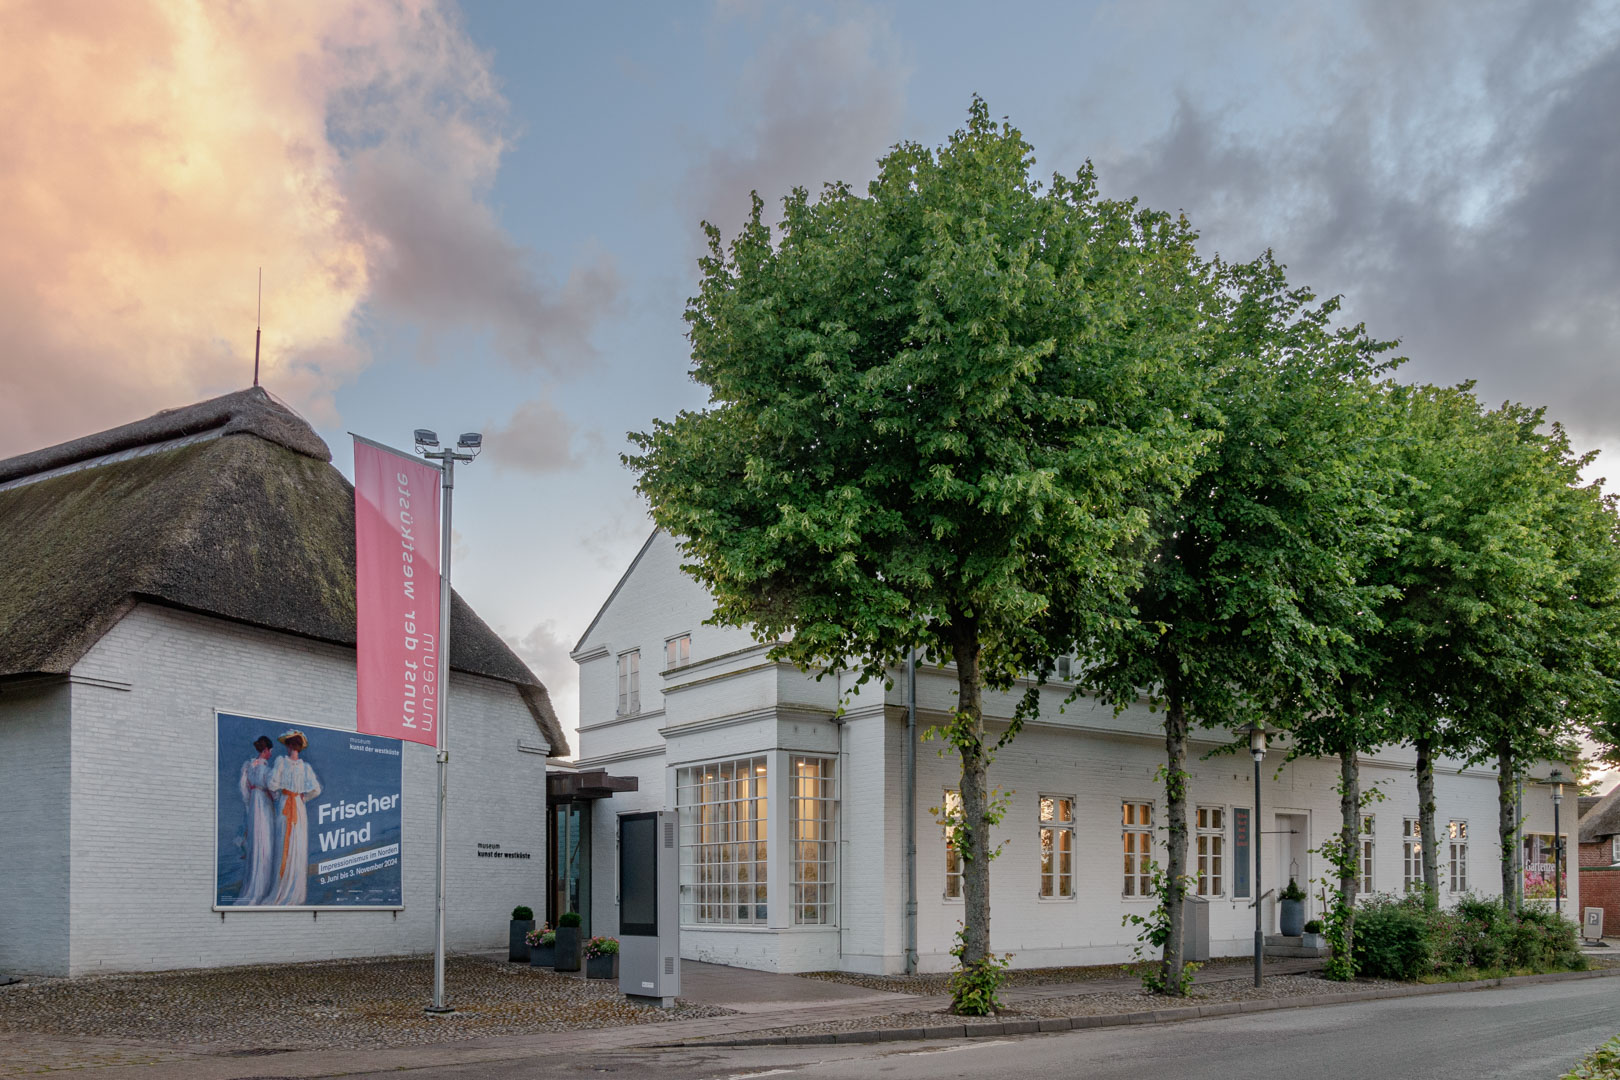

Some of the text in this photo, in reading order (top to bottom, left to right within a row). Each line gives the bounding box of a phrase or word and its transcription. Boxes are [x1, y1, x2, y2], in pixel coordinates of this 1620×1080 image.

[319, 794, 399, 825] Frischer
[319, 822, 371, 852] Wind
[320, 846, 398, 872] Impressionismus im Norden
[478, 850, 493, 858] kunst
[320, 877, 326, 885] 9.
[326, 873, 339, 883] Juni
[340, 871, 349, 879] bis
[356, 863, 384, 875] November
[384, 858, 398, 867] 2024
[1590, 913, 1598, 925] P
